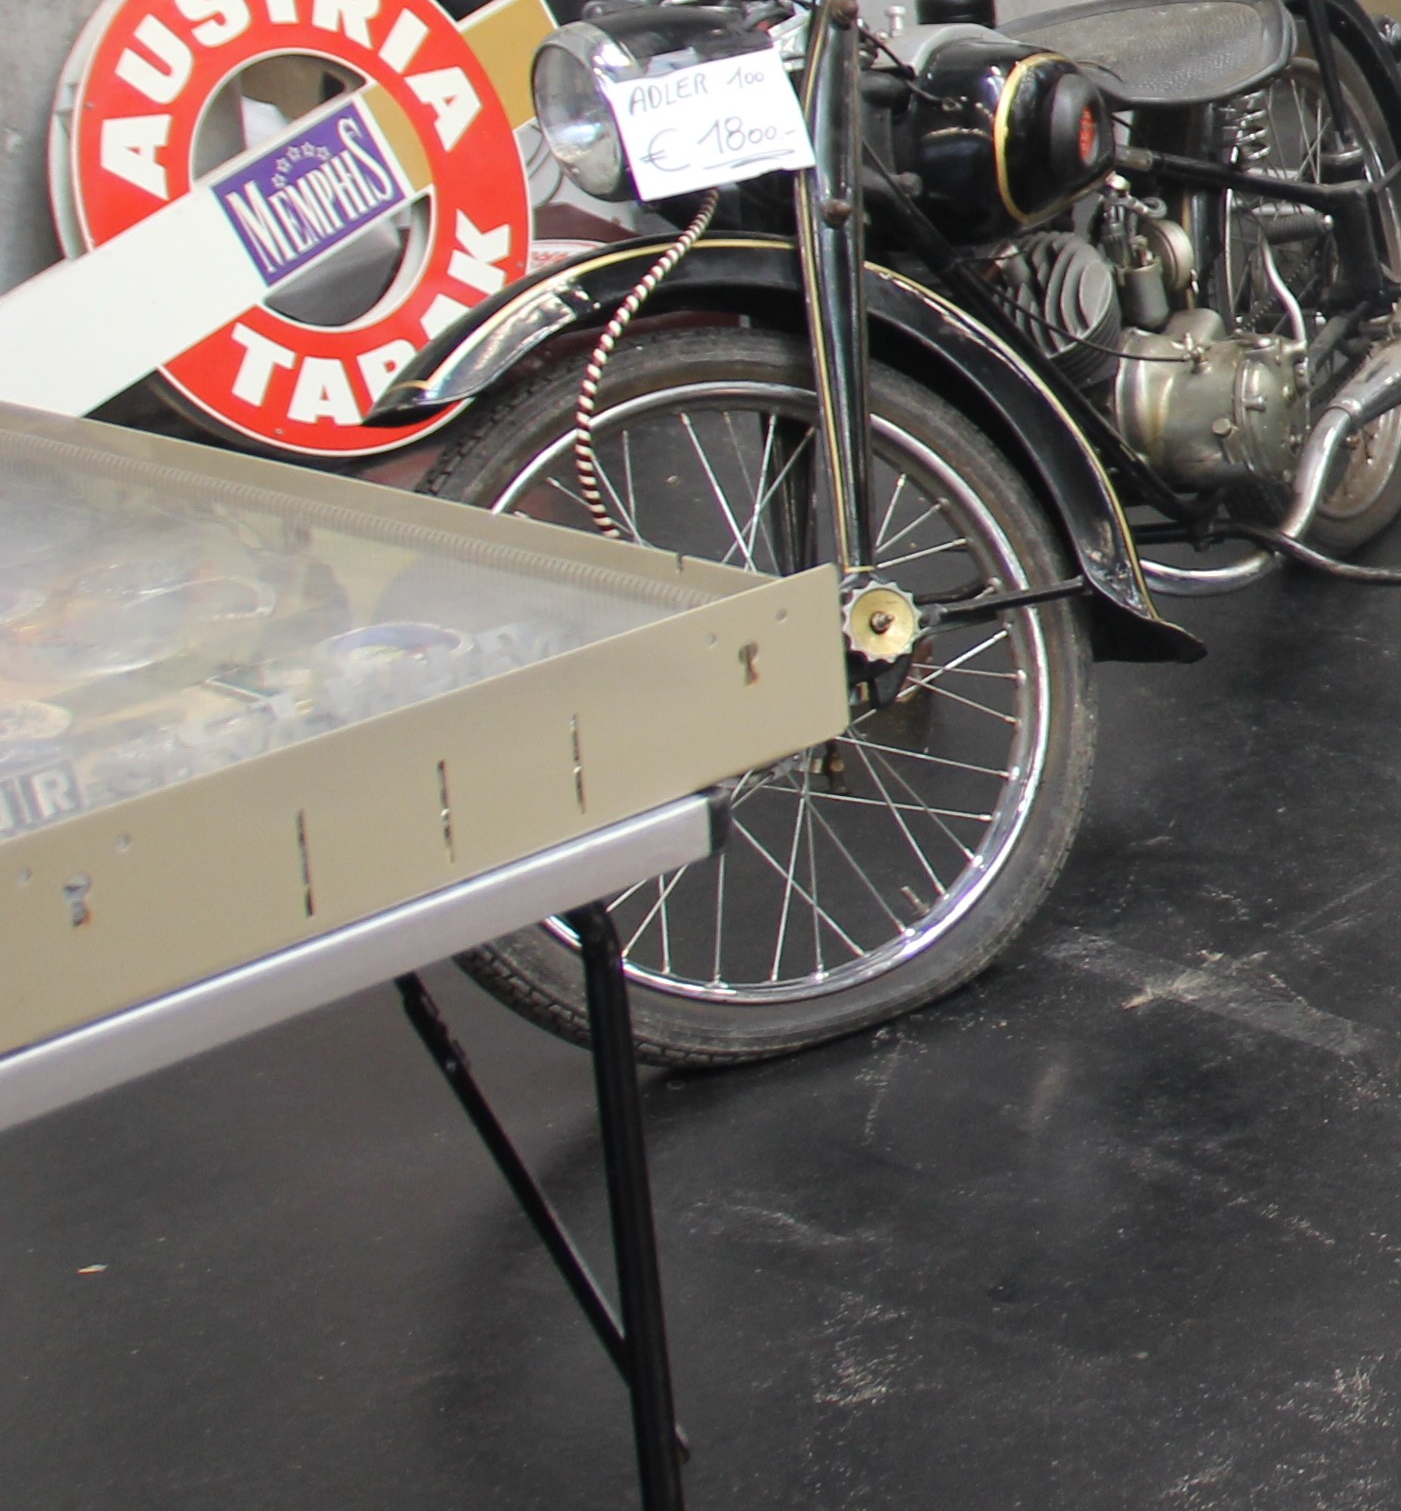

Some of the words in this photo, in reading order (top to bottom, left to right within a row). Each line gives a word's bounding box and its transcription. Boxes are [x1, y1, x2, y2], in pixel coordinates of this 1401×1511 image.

[628, 72, 709, 117] ADLER
[726, 65, 766, 90] 100
[638, 127, 692, 173] €
[224, 115, 394, 275] MEMPHIS
